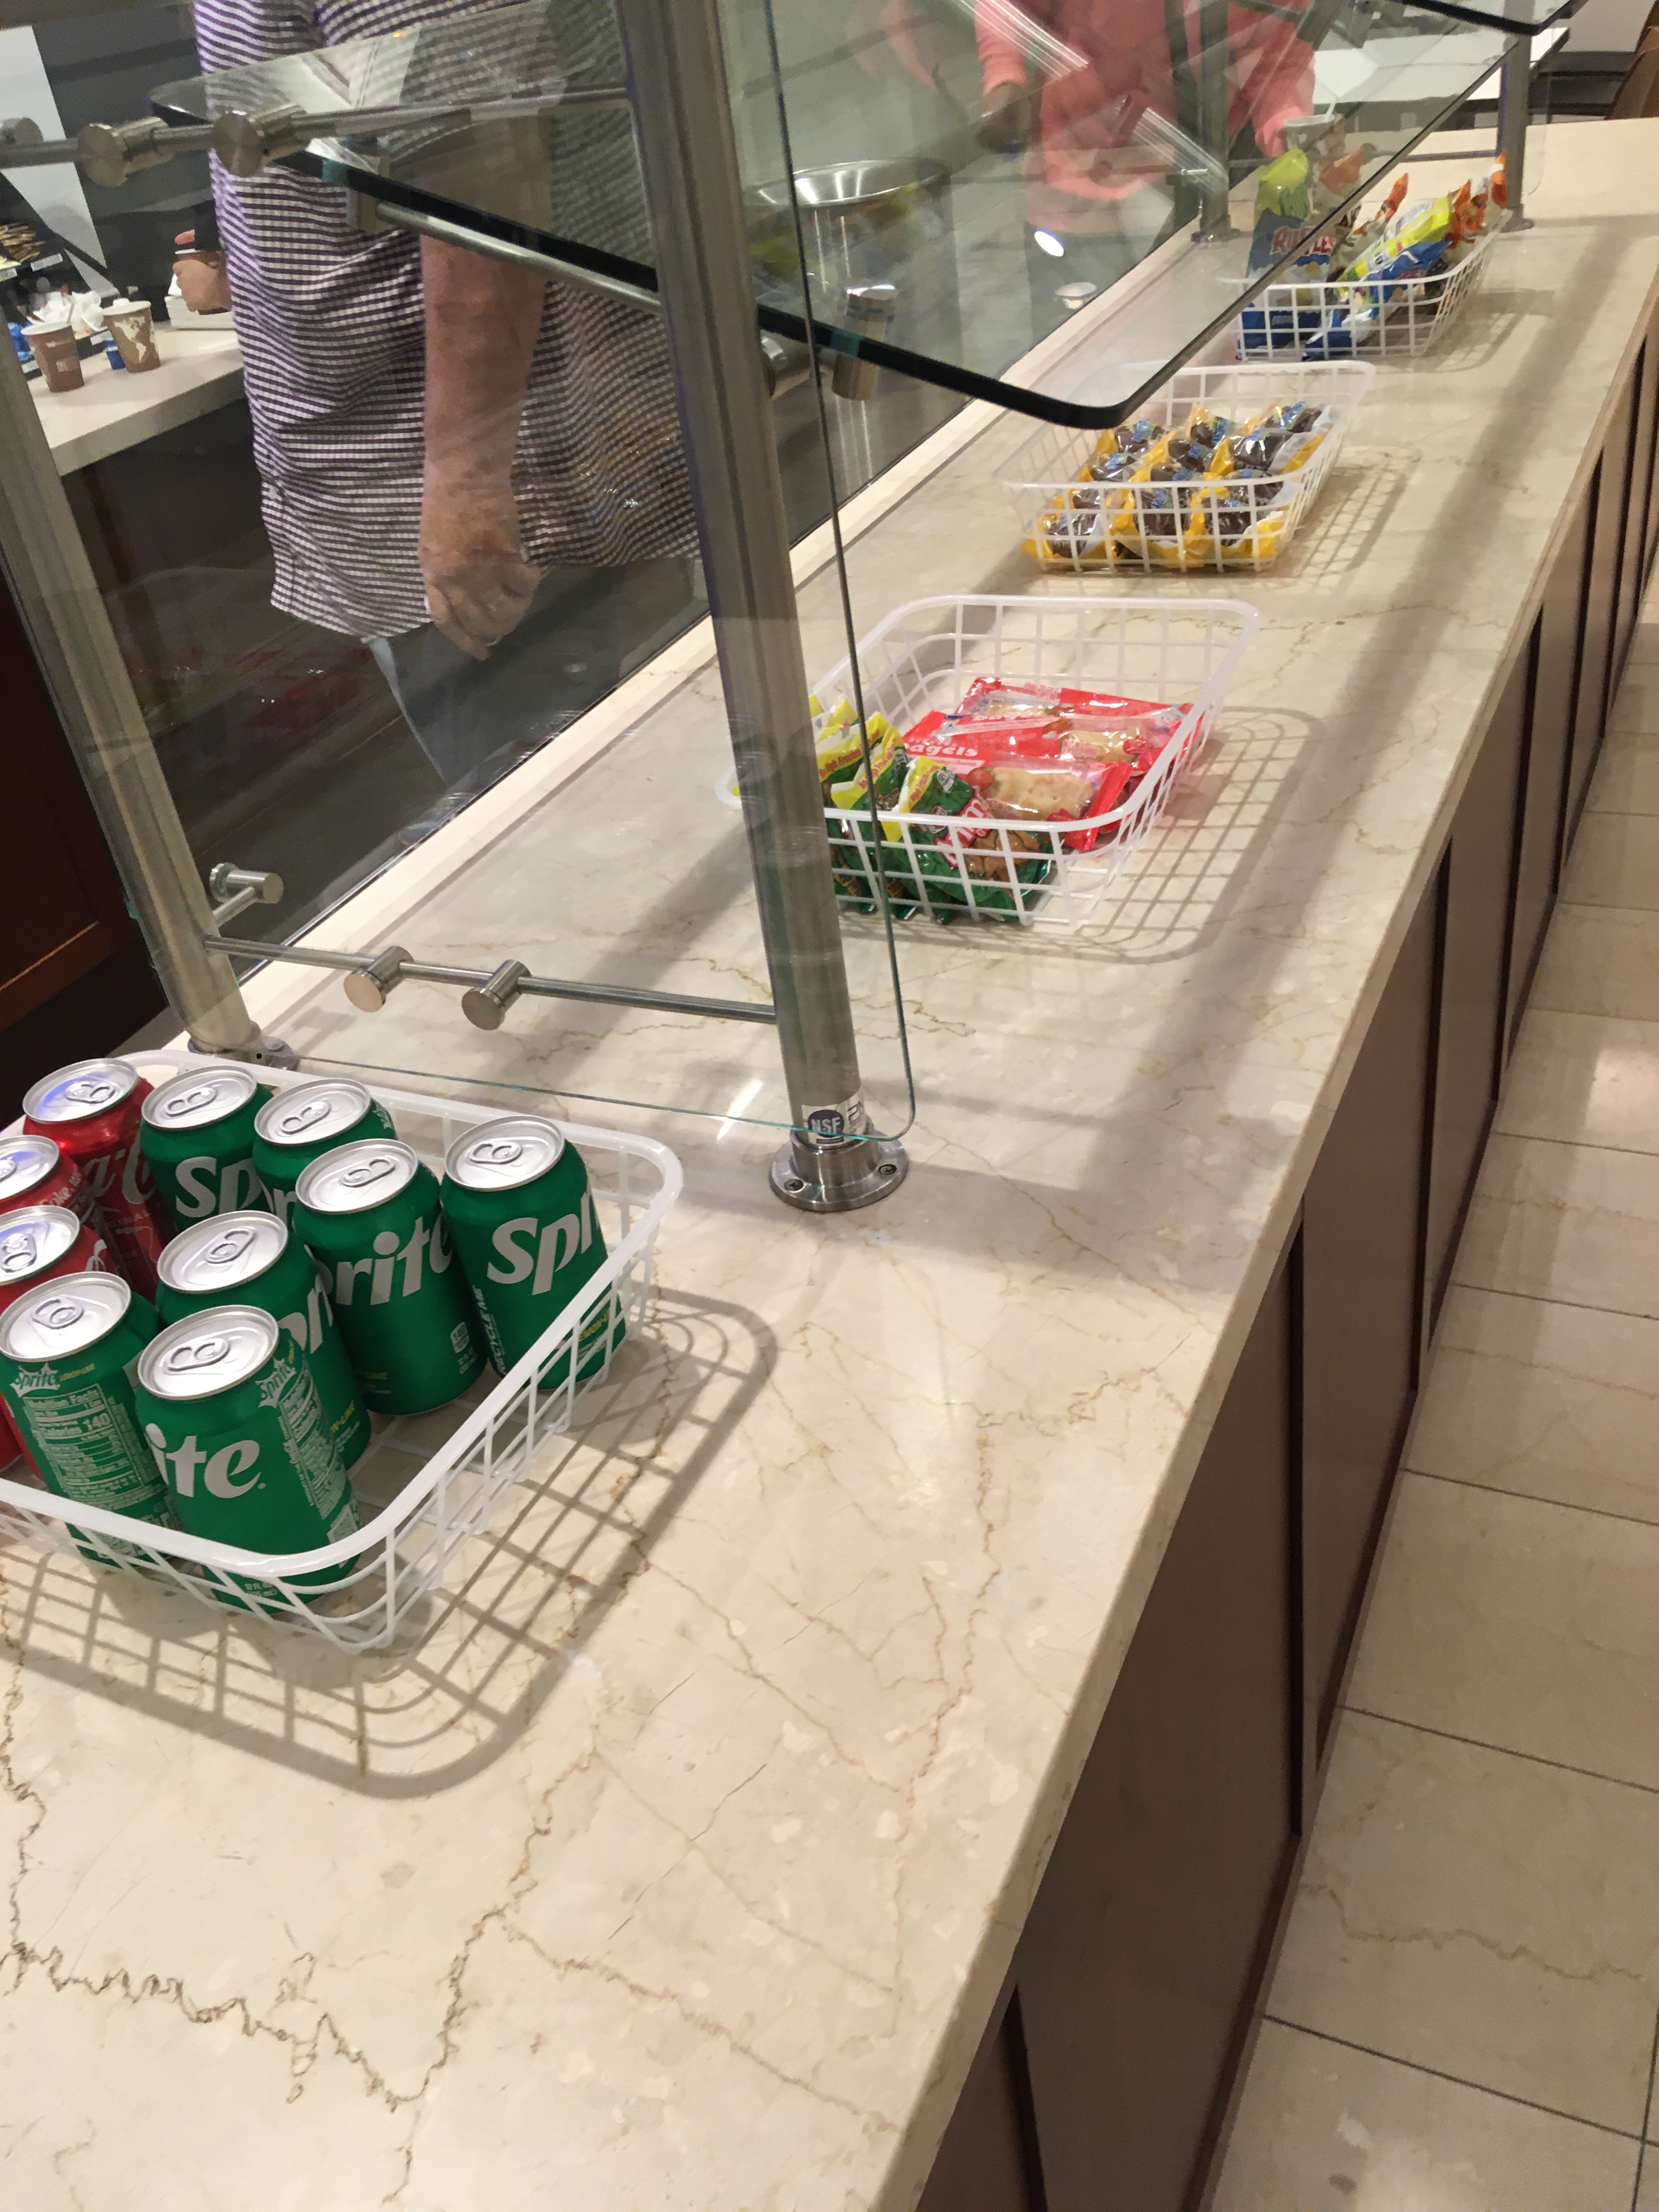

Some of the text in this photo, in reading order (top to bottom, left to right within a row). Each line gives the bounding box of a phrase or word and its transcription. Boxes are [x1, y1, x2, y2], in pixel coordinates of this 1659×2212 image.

[811, 1116, 841, 1135] NSF
[14, 1370, 57, 1390] Sprite
[83, 1412, 110, 1431] 140
